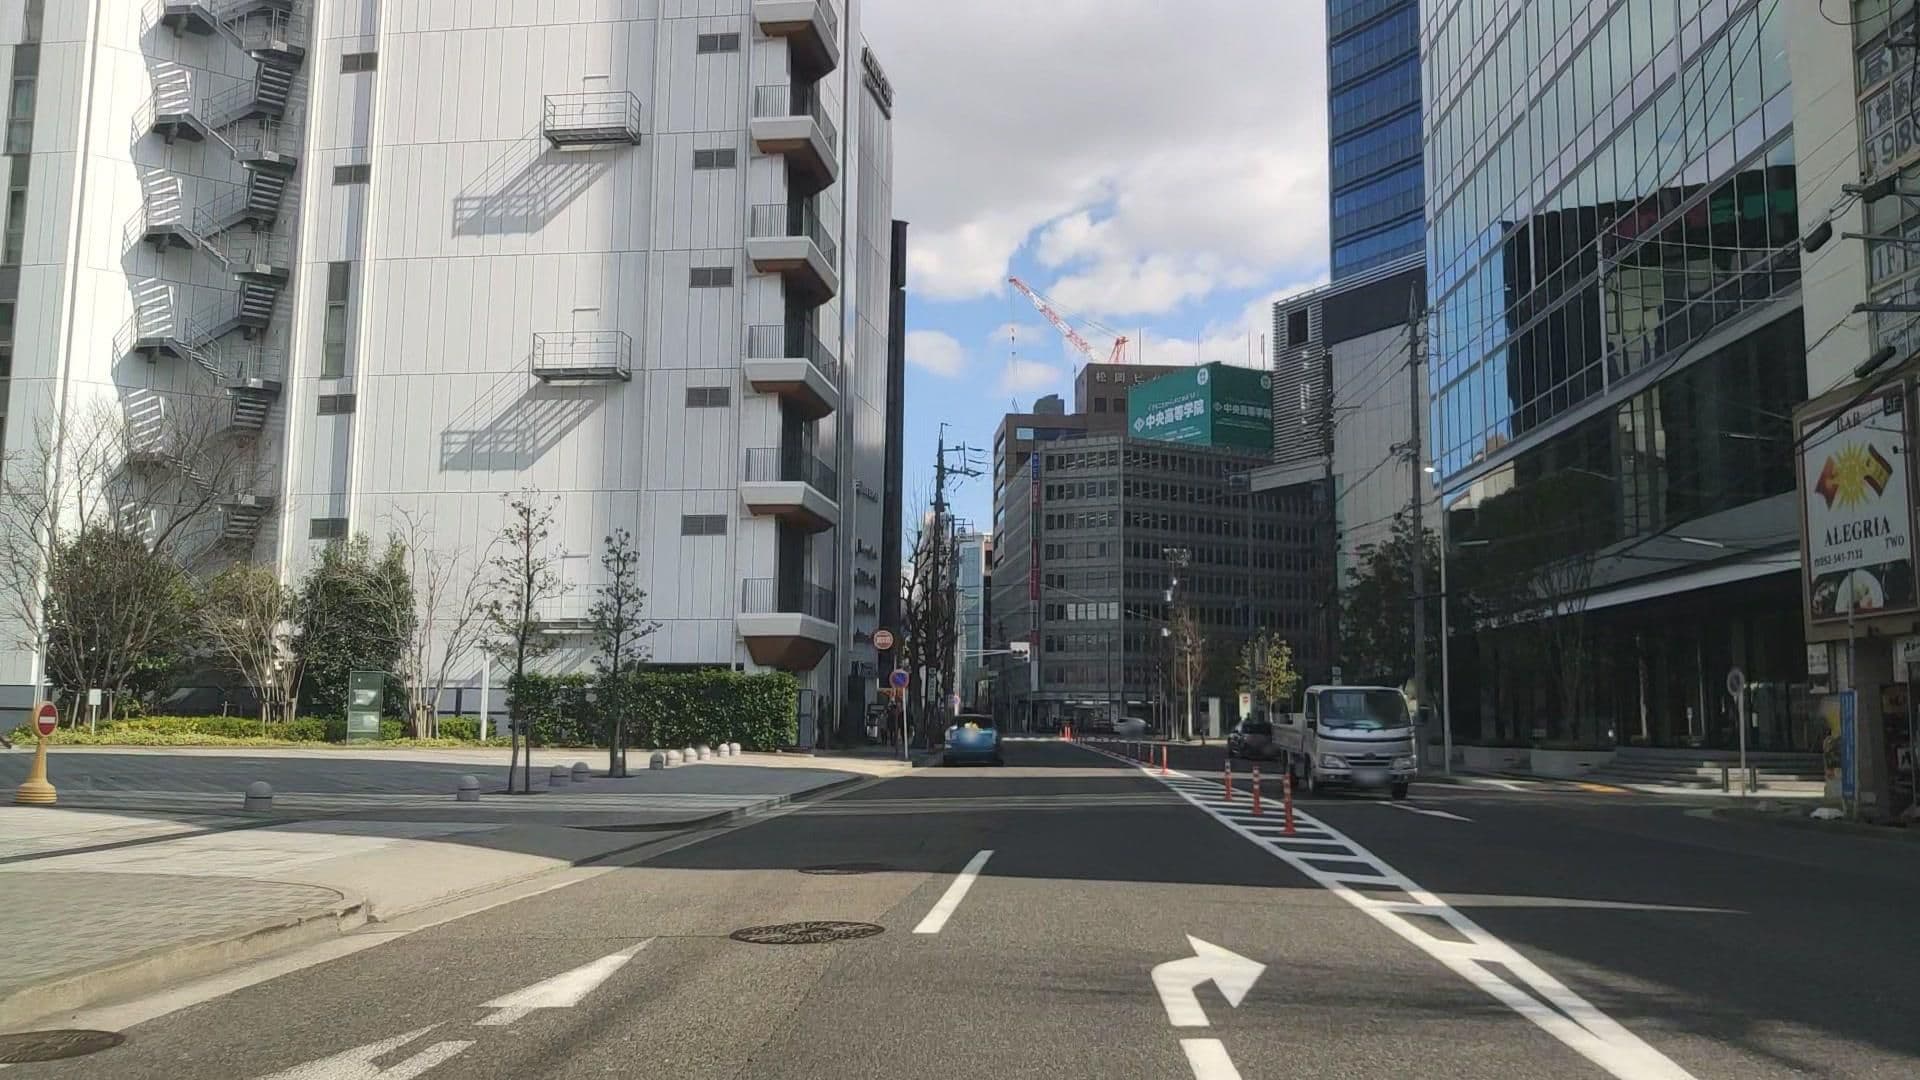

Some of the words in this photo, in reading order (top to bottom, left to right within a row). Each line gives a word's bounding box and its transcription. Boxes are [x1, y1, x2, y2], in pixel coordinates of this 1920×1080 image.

[1146, 399, 1204, 430] 中央高等学院
[1837, 411, 1860, 433] BAR
[1824, 515, 1890, 547] ALEGRIA
[1885, 535, 1905, 550] TWO
